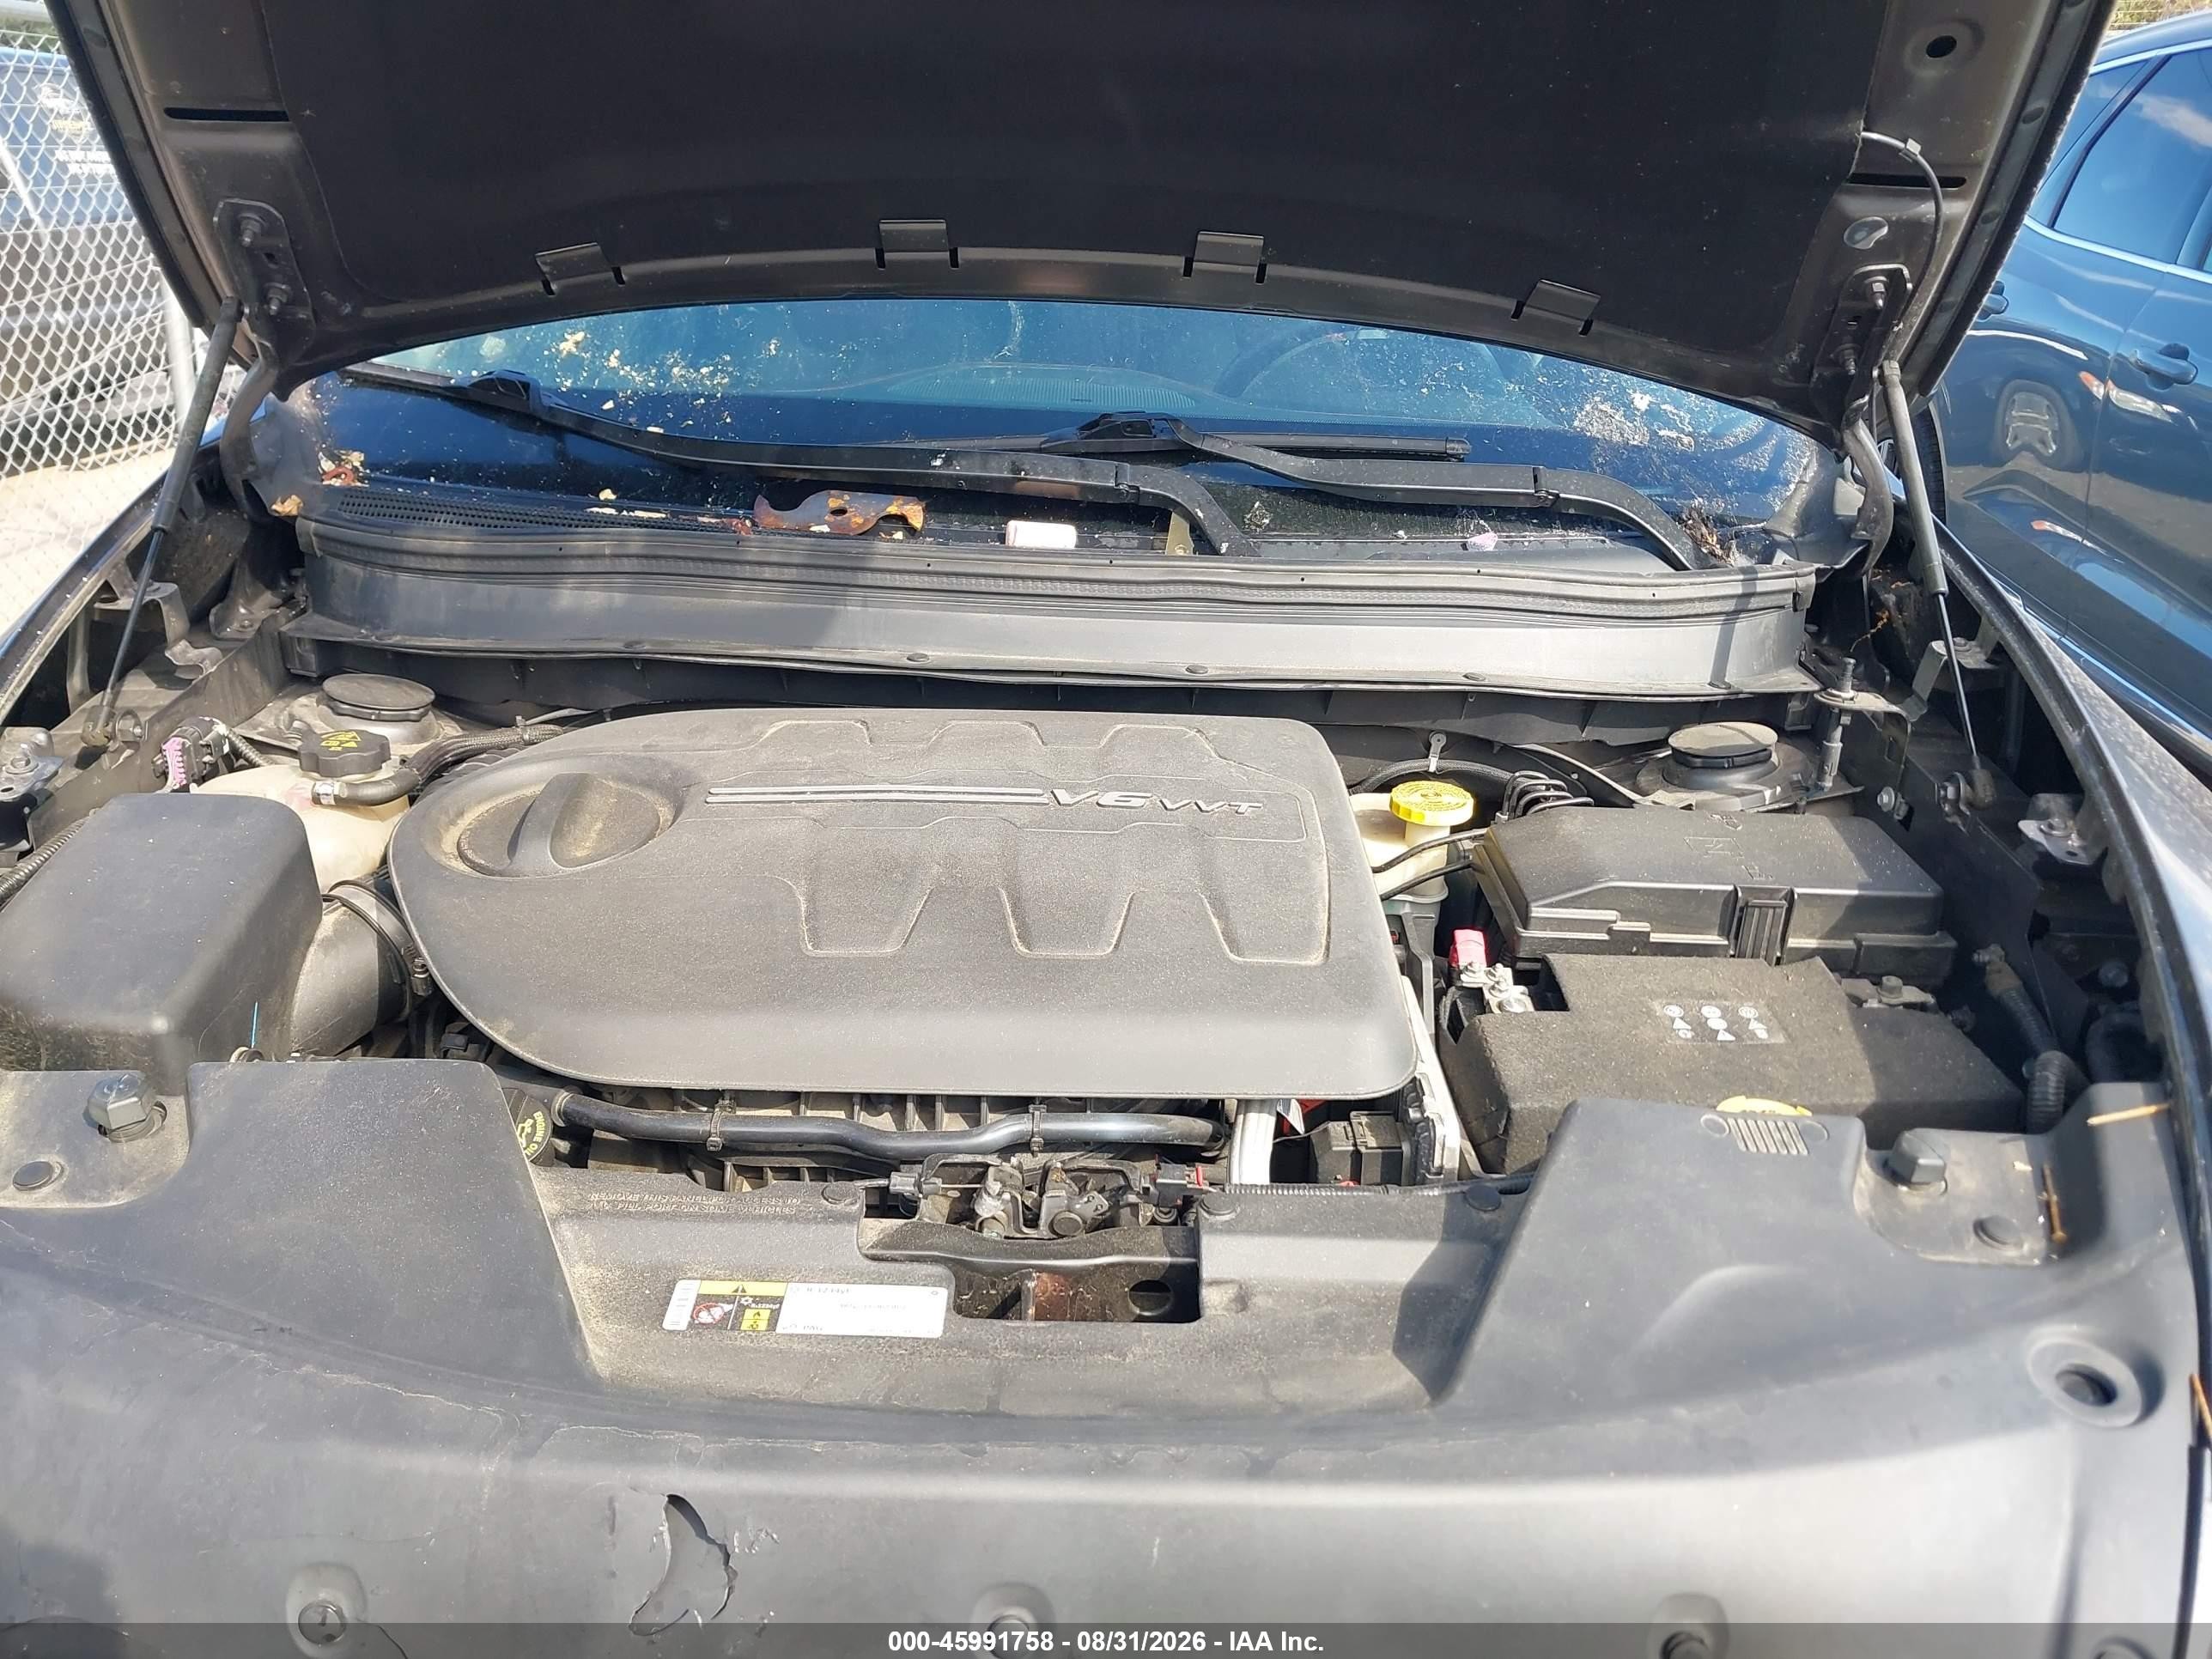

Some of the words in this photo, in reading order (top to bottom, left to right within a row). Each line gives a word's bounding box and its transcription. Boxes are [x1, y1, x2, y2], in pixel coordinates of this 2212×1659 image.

[1050, 788, 1153, 808] V6
[1159, 798, 1263, 815] VVT
[533, 1111, 545, 1143] ENGINE
[589, 1192, 639, 1201] REMOVE
